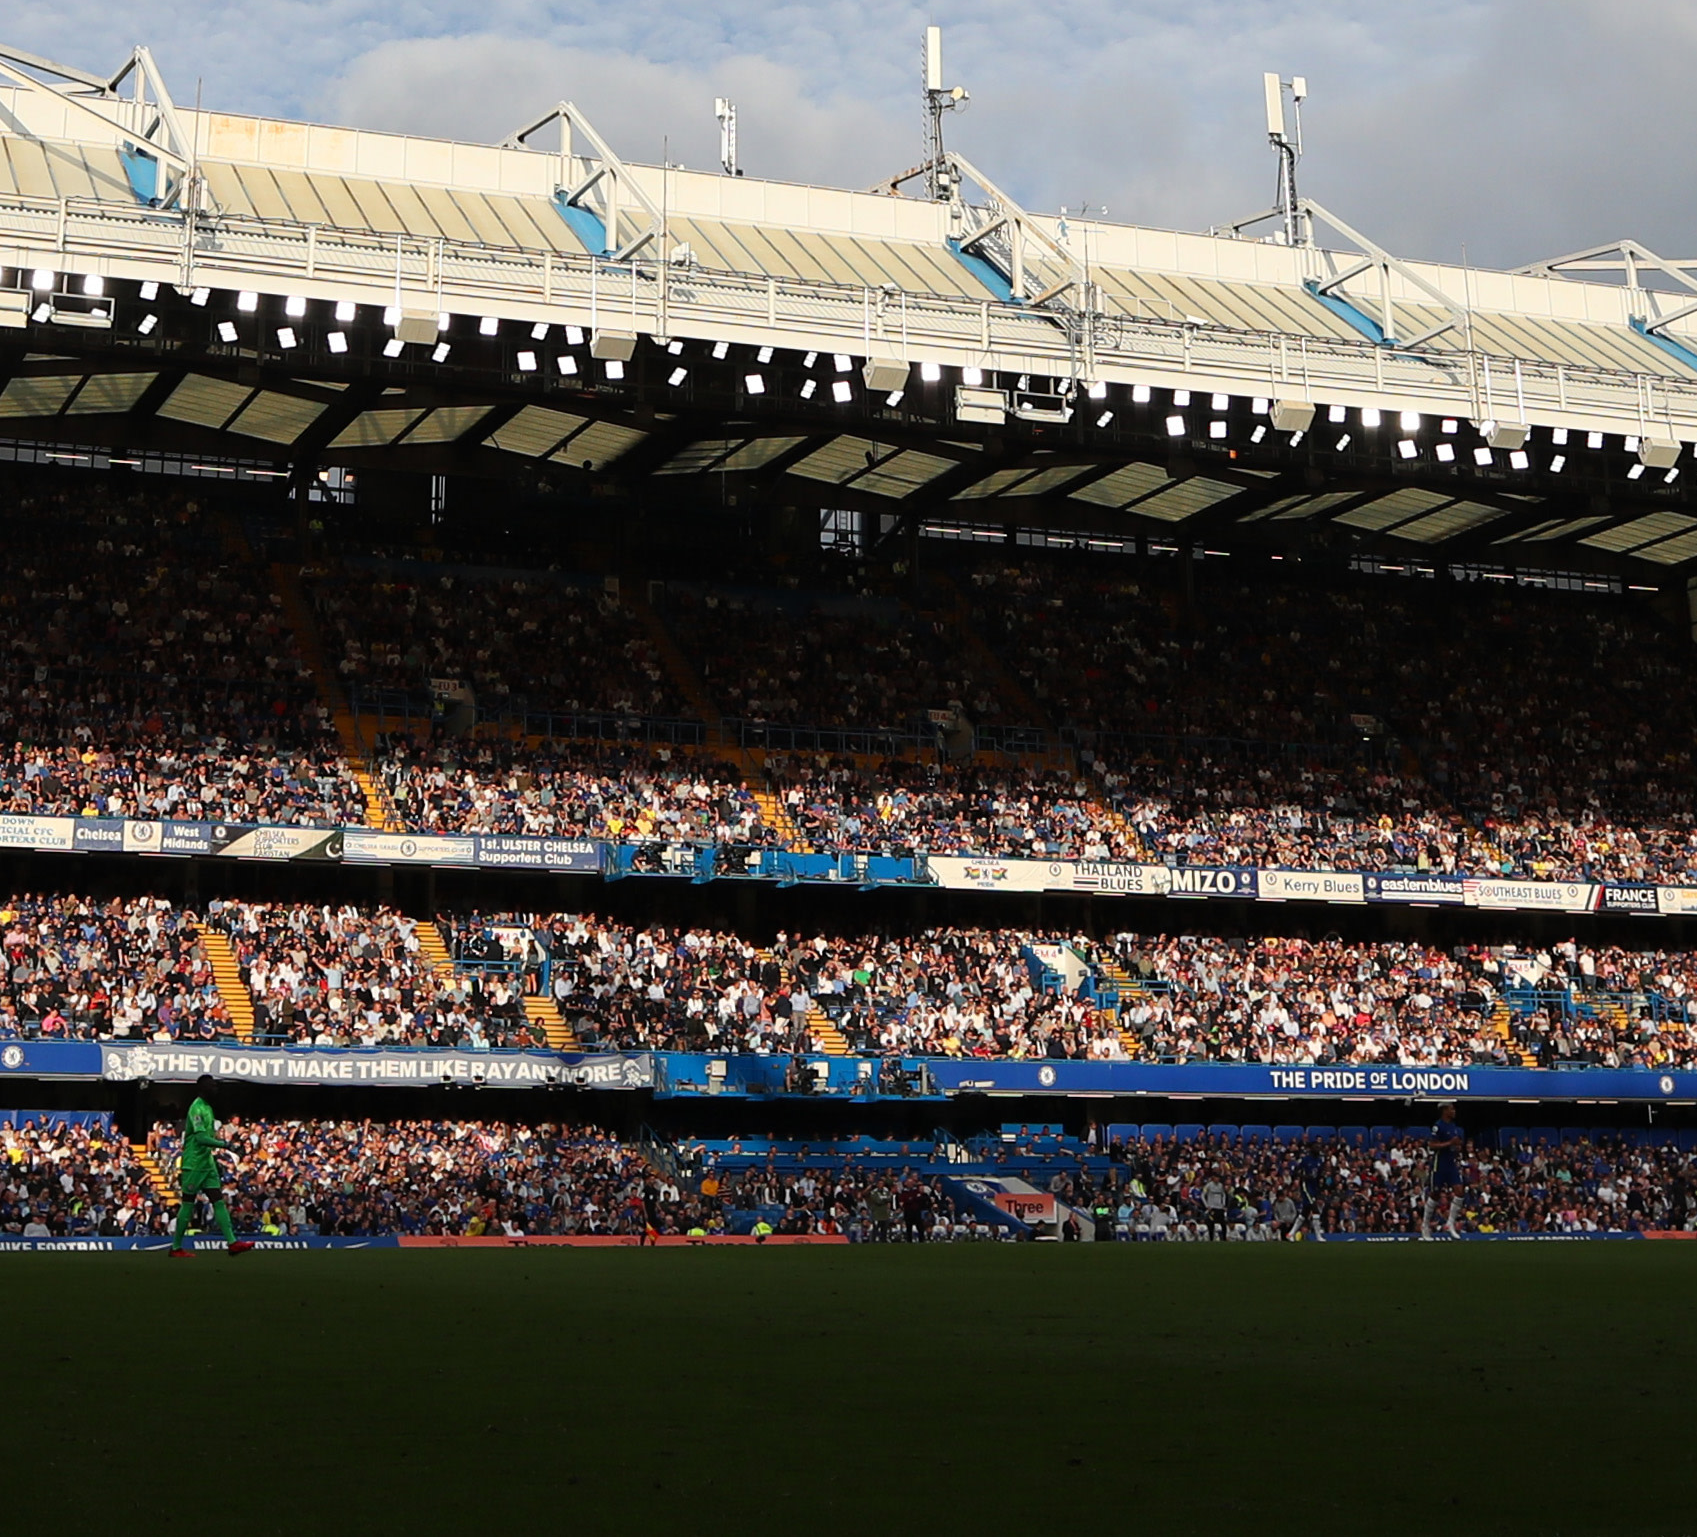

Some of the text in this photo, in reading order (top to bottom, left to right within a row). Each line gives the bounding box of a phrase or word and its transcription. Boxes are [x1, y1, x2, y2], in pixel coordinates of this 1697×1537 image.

[2, 817, 35, 825] DOWN
[76, 828, 122, 841] Chelsea
[173, 826, 200, 837] West
[39, 836, 67, 846] CLUB
[163, 837, 208, 850] Midlands
[255, 836, 300, 846] SUPPORTERS
[480, 839, 594, 854] 1st. ULSTER CHELSEA
[479, 851, 572, 865] Supporters Club
[1073, 863, 1142, 877] THAILAND
[1101, 878, 1143, 891] BLUES
[1172, 870, 1236, 893] MIZO
[1284, 878, 1359, 894] Kerry Blues
[1381, 878, 1463, 893] easternblues
[1535, 888, 1562, 900] BLUES
[1605, 888, 1655, 902] FRANCE
[154, 1054, 216, 1072] THEY
[219, 1058, 284, 1077] DON'T
[288, 1060, 353, 1078] MAKE
[356, 1059, 416, 1078] THEM
[420, 1060, 468, 1078] LIKE
[1270, 1072, 1469, 1090] THE PRIDE OF LONDON
[1005, 1200, 1044, 1213] Three
[37, 1242, 113, 1251] FOOTBALL
